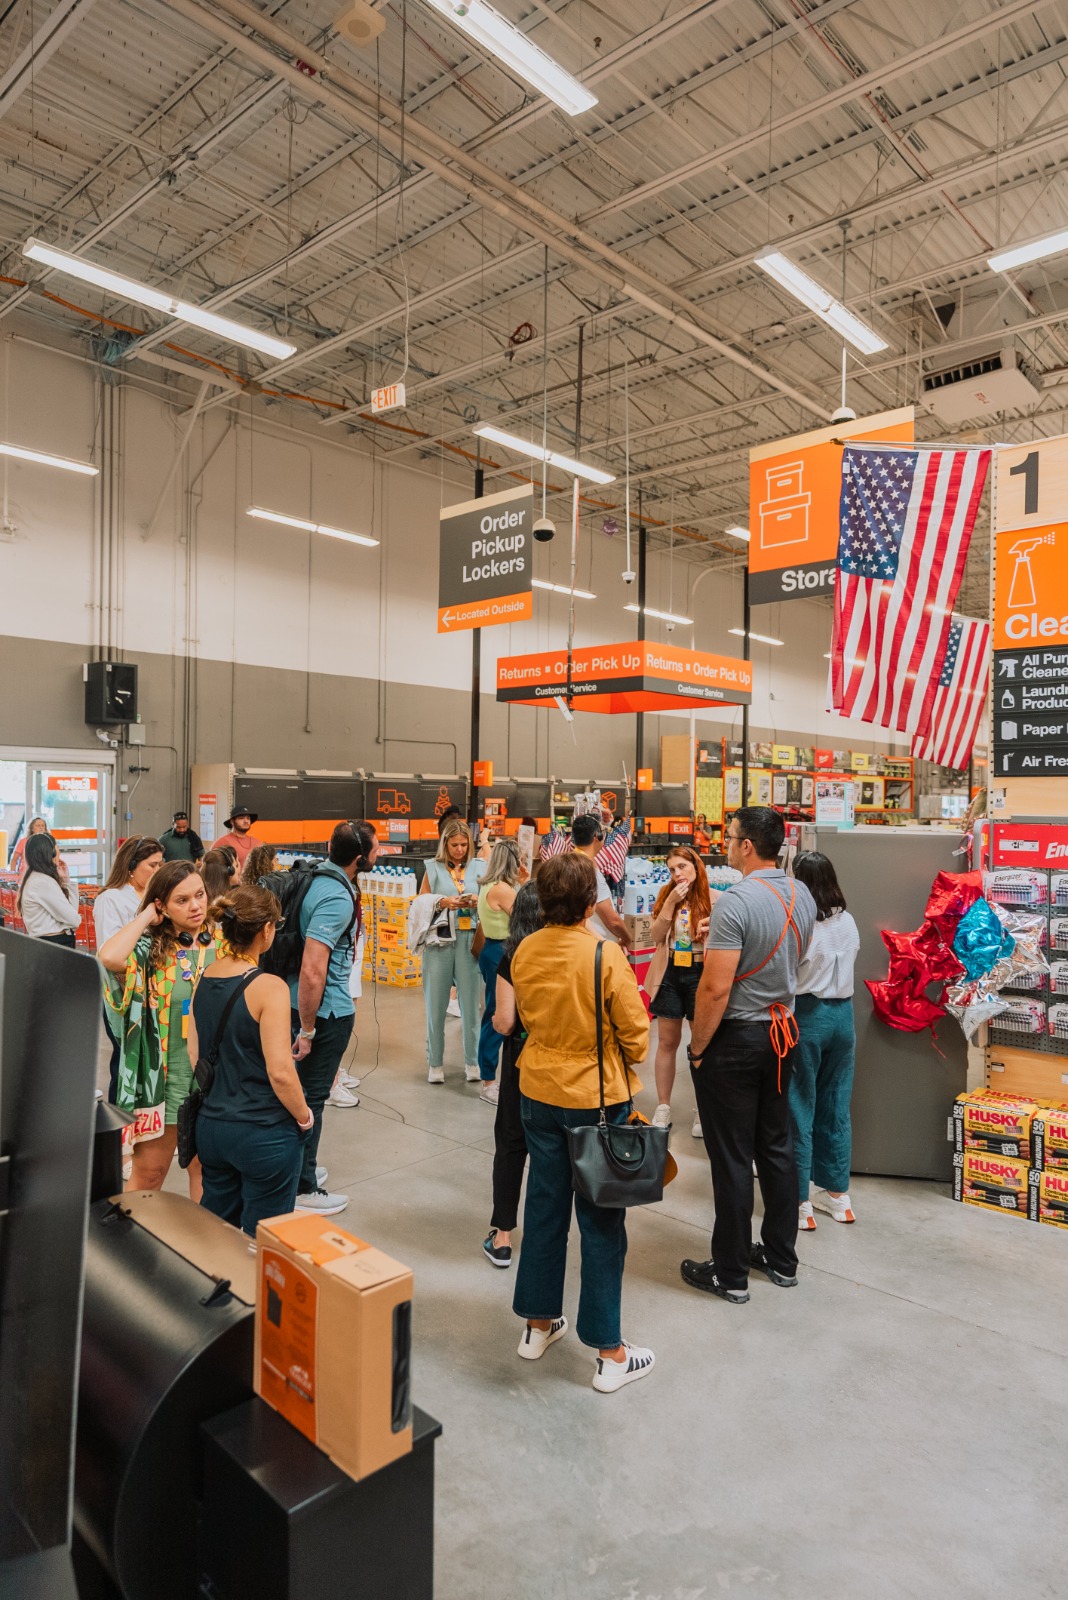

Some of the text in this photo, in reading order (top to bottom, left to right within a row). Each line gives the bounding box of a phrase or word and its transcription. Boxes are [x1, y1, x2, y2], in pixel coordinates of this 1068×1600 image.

[377, 386, 397, 409] EXIT
[1010, 451, 1039, 515] 1
[480, 510, 525, 534] Order
[472, 533, 525, 559] Pickup
[463, 556, 525, 583] Lockers
[456, 601, 524, 621] Located Outside
[499, 666, 541, 680] Returns
[591, 656, 618, 671] Pick
[622, 654, 640, 670] Up
[1022, 653, 1068, 667] All Pur
[646, 653, 751, 685] Returns Order Pick Up
[678, 683, 724, 698] Customer Service
[1023, 724, 1063, 737] Paper
[1022, 756, 1041, 767] Air
[390, 822, 407, 831] Enter
[673, 824, 689, 833] Exit
[994, 873, 1022, 882] Energizer
[642, 921, 650, 929] 30
[953, 1105, 964, 1115] 50
[968, 1109, 1020, 1127] HUSKY
[1033, 1121, 1044, 1131] 50
[953, 1153, 964, 1164] 50
[968, 1158, 1020, 1178] HUSKY
[1028, 1171, 1040, 1182] 50
